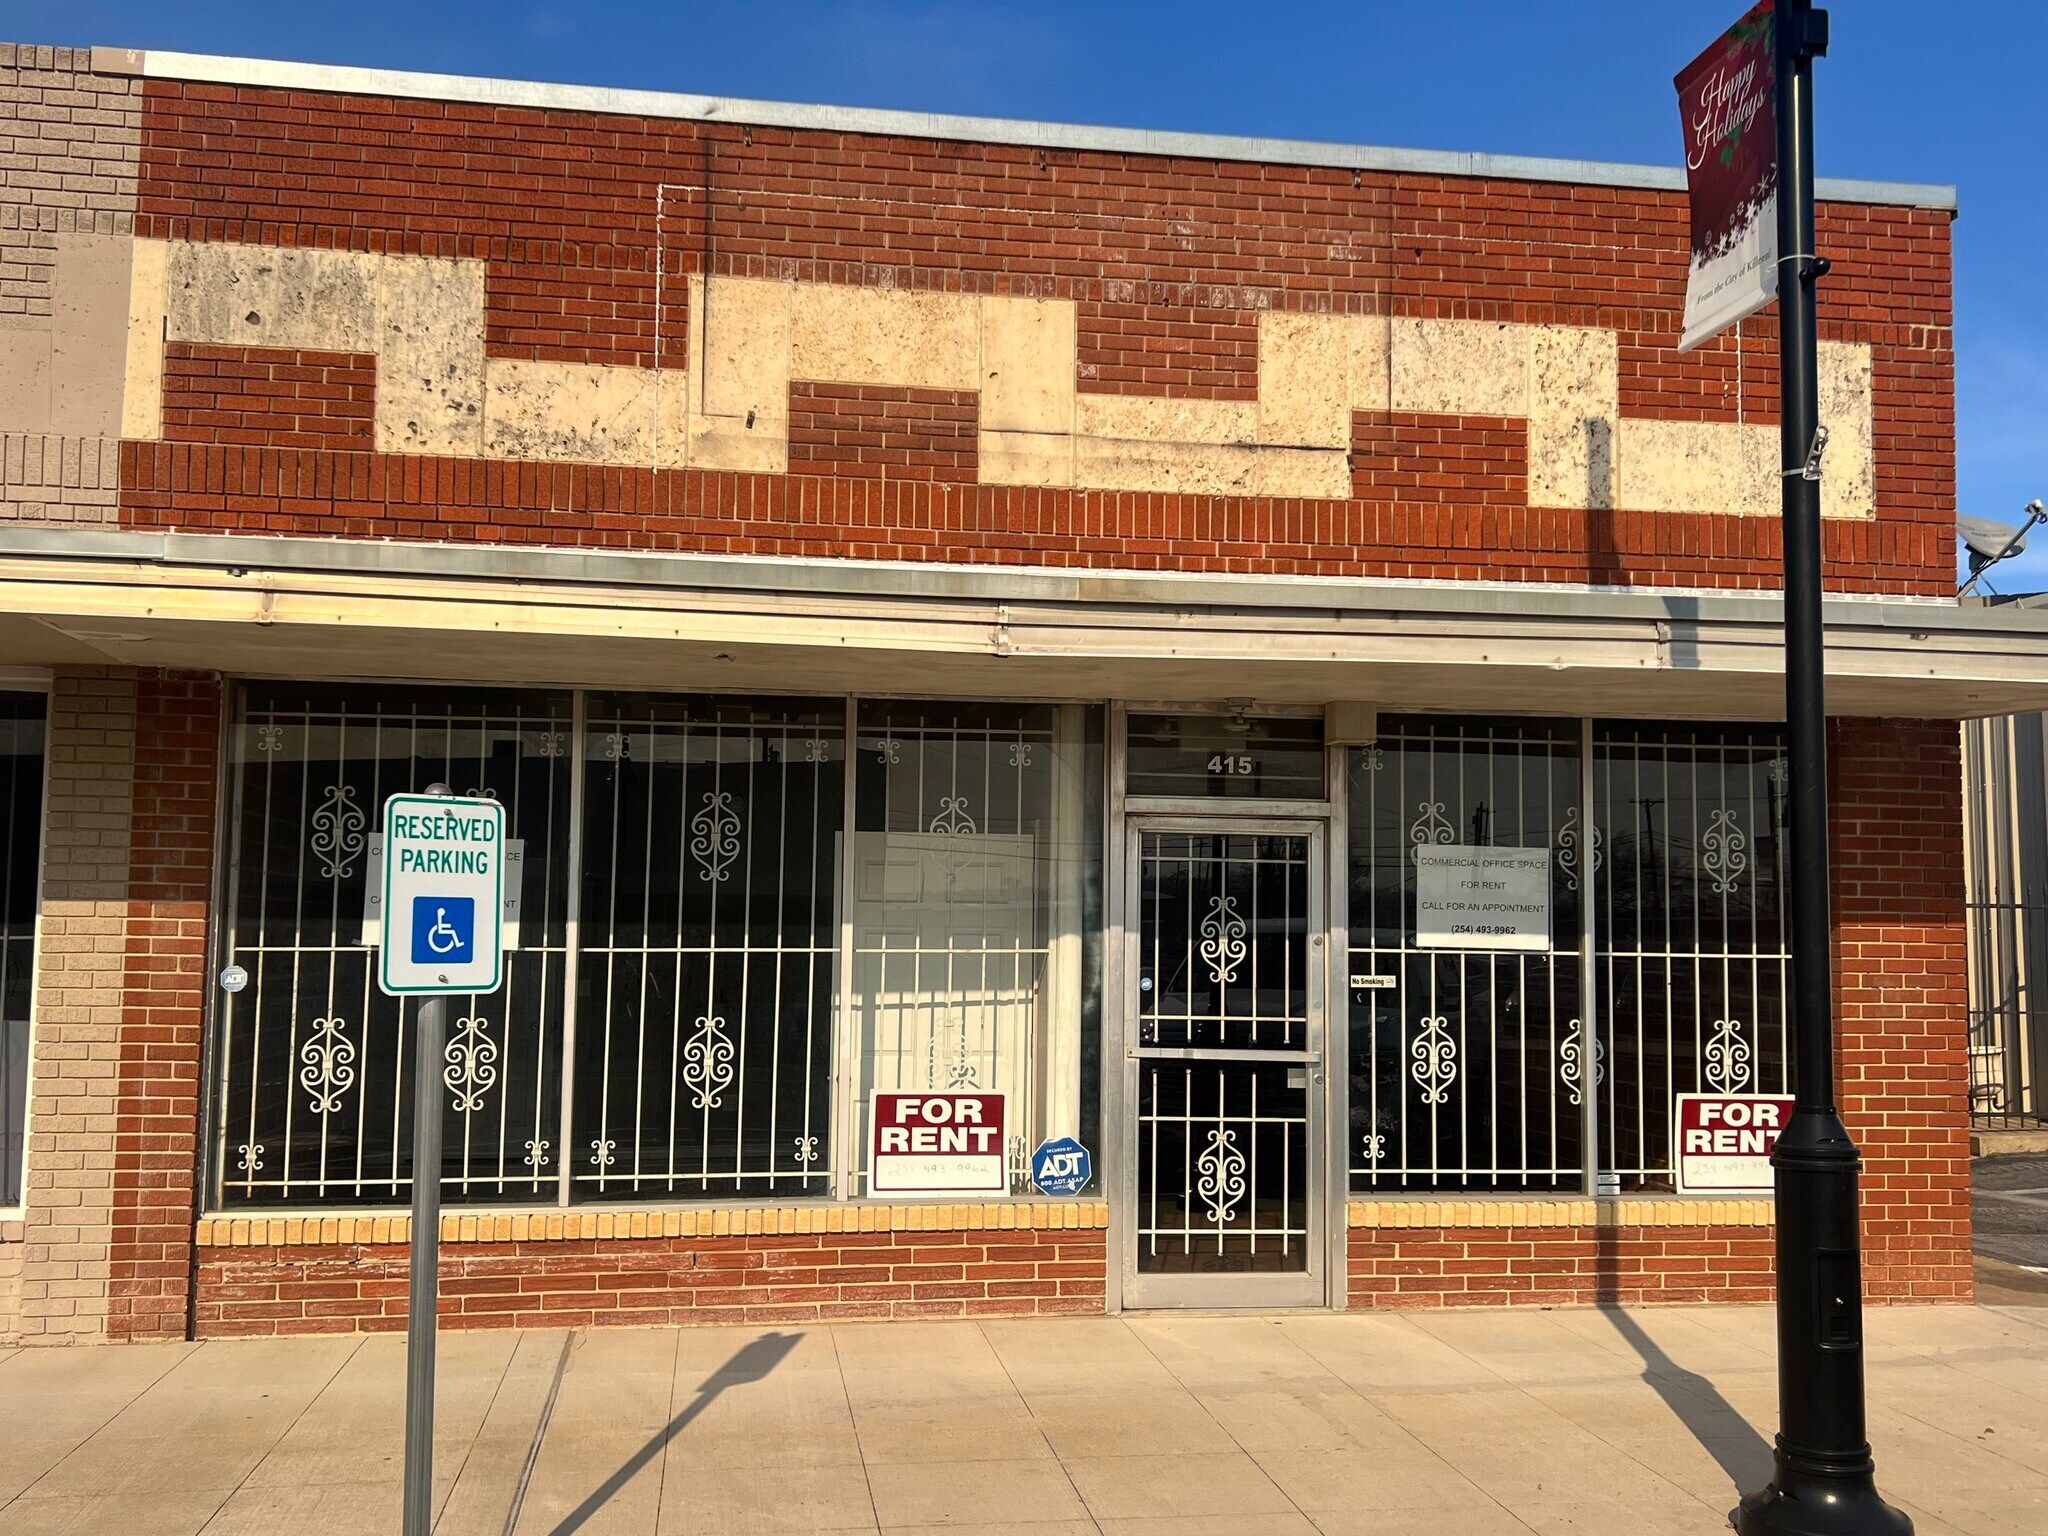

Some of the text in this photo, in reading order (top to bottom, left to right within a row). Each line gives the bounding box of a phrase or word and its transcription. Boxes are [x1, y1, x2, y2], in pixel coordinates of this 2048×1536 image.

[1693, 59, 1757, 130] Happy
[1688, 86, 1766, 169] Holidays
[1697, 290, 1713, 305] From
[1714, 282, 1724, 294] the
[1725, 273, 1738, 287] City
[1739, 262, 1747, 277] of
[1207, 755, 1253, 775] 415
[395, 815, 495, 842] RESERVED
[401, 848, 489, 874] PARKING
[1421, 858, 1547, 869] COMMERCIAL OFFICE SPACE
[1461, 881, 1506, 890] FOR RENT
[1422, 901, 1444, 910] CALL
[1447, 902, 1465, 911] FOR
[1482, 904, 1545, 913] APPOINTMENT
[1451, 925, 1516, 935] (254) 493-9962
[224, 974, 244, 984] ADT
[1361, 978, 1384, 988] Smoking
[896, 1098, 983, 1124] FOR
[1699, 1103, 1779, 1128] FOR
[880, 1127, 997, 1152] RENT
[1039, 1152, 1083, 1179] ADT
